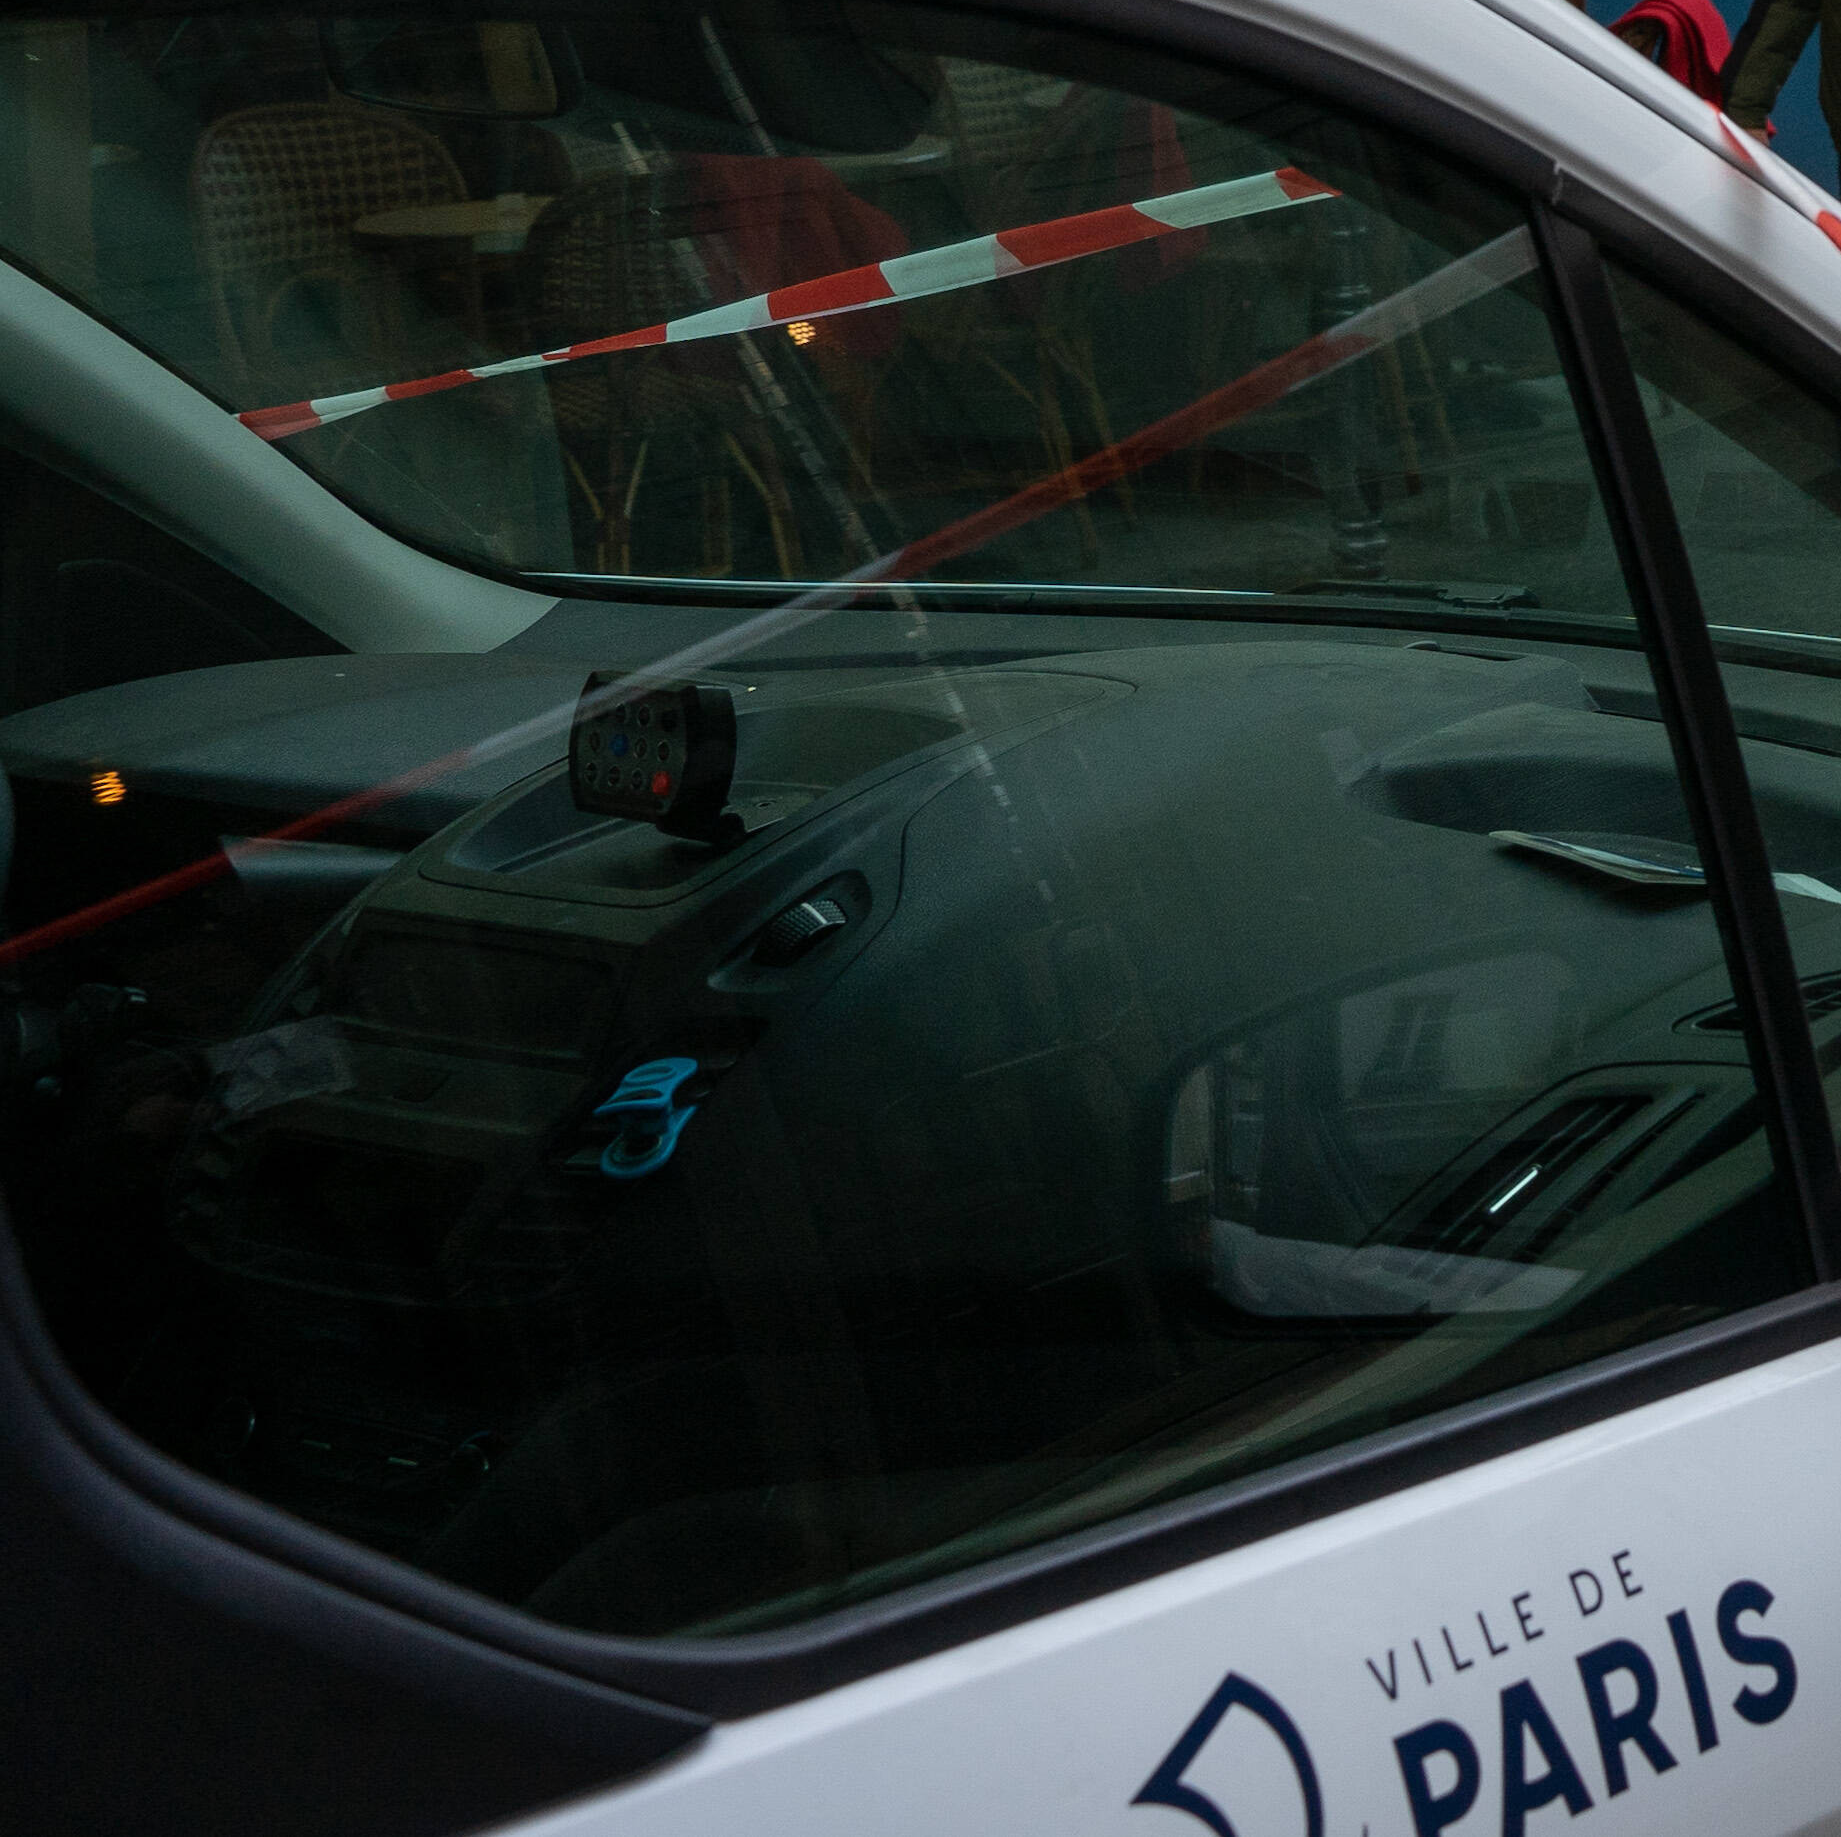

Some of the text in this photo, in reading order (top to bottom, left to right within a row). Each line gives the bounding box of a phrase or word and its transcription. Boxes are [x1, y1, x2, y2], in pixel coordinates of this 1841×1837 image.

[1366, 1549, 1644, 1702] VILLE DE
[1393, 1579, 1798, 1837] PARIS
